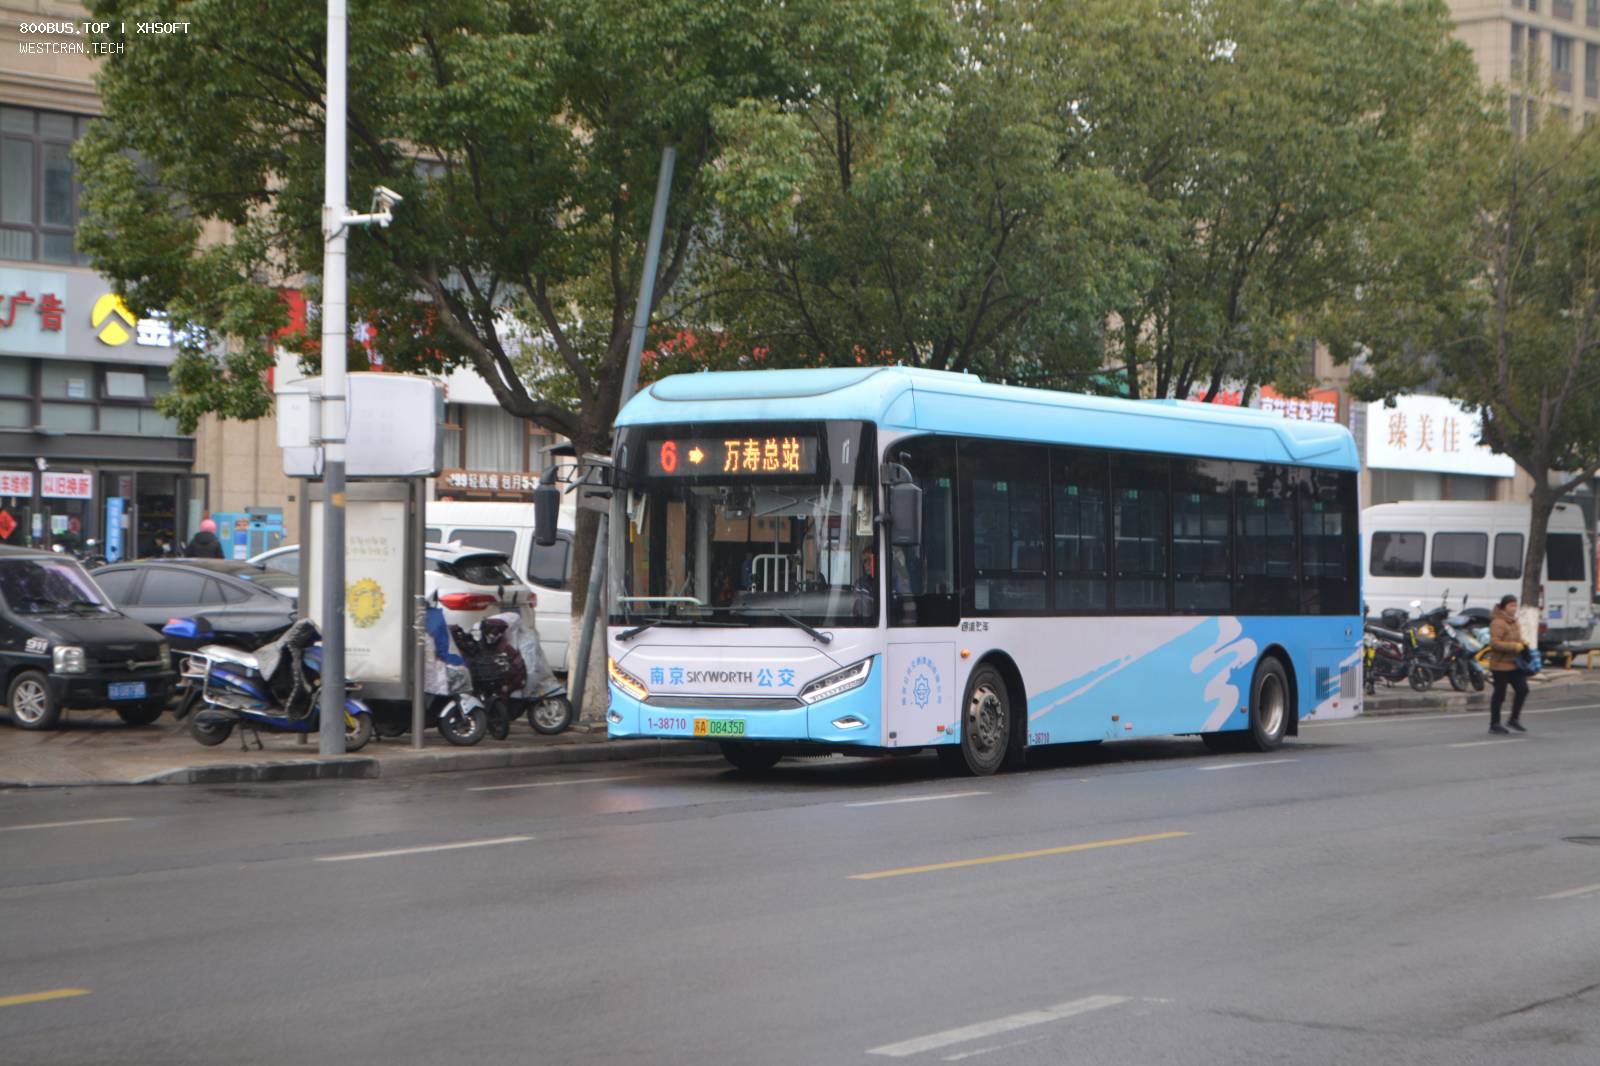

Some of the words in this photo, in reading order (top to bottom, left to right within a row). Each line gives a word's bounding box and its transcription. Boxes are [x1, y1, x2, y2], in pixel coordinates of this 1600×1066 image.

[0, 291, 65, 331] 广告
[1387, 412, 1461, 453] 臻美佳
[660, 440, 677, 473] 6
[723, 437, 800, 472] 万寿总站
[650, 667, 684, 685] 南京
[687, 671, 752, 683] SKYWORTH
[757, 668, 796, 688] 公交
[648, 718, 686, 730] 1-38710
